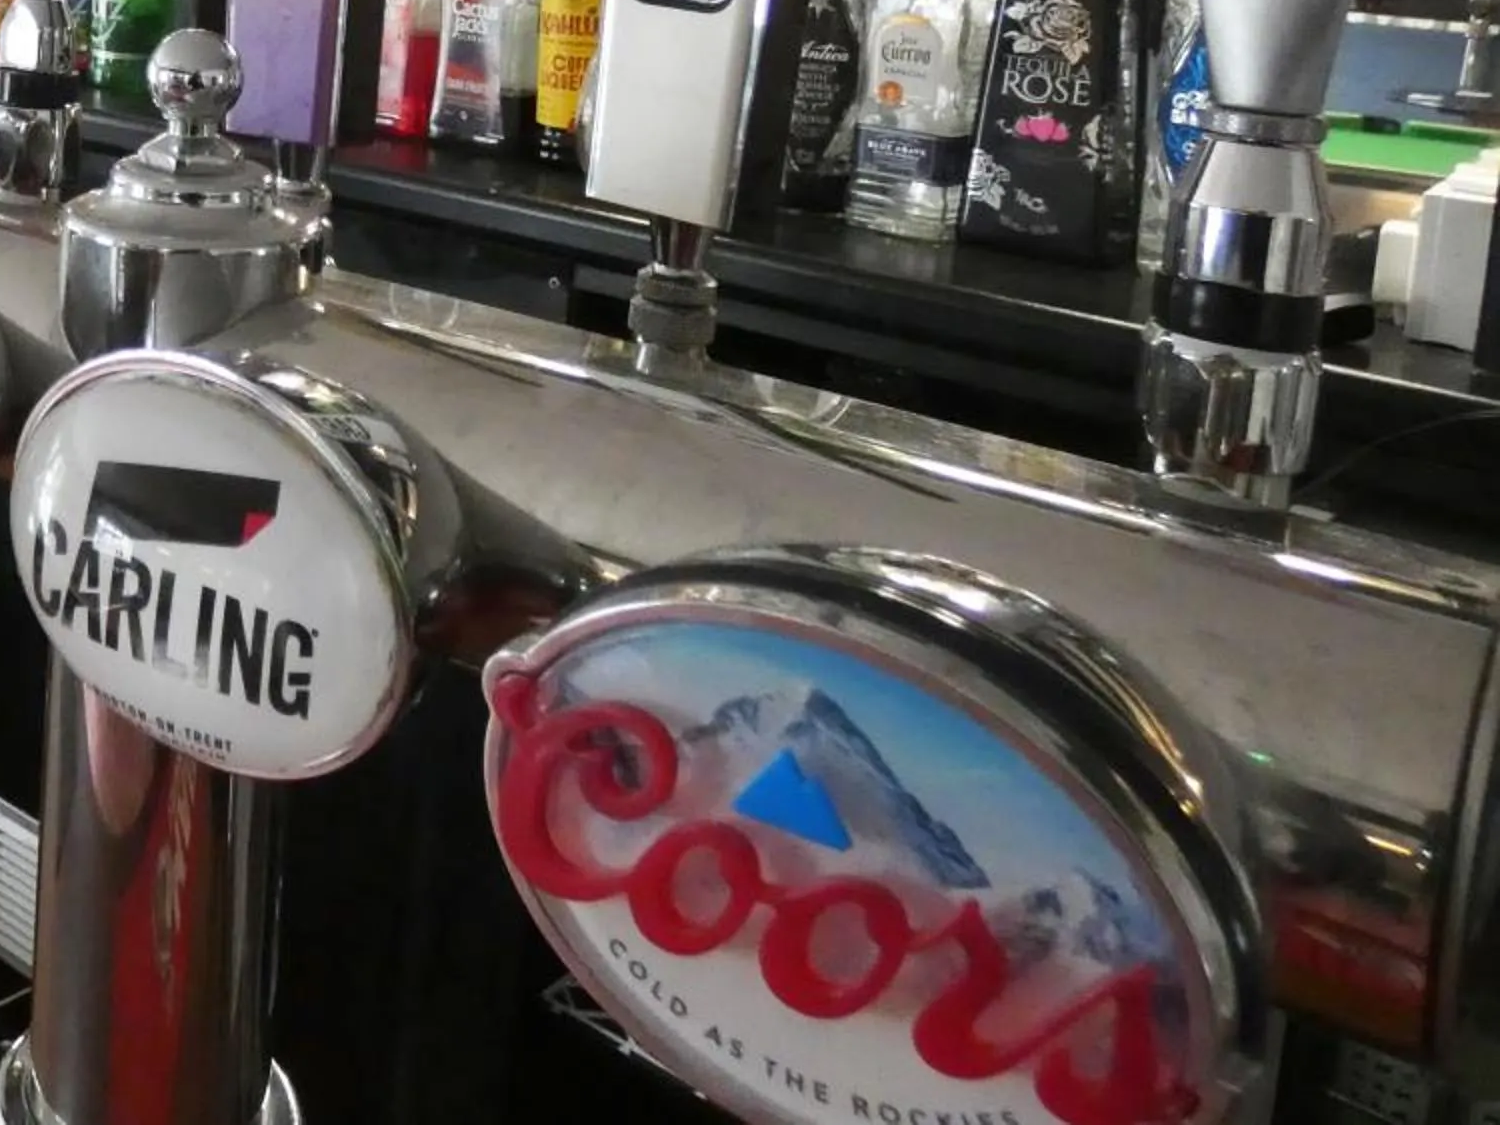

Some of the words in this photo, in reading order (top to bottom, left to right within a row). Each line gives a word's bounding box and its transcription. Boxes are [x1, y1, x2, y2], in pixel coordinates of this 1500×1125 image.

[543, 6, 599, 36] KAHLÚ
[553, 55, 591, 74] COFF
[1004, 53, 1092, 82] TEQUILA
[1001, 68, 1092, 107] ROSE
[32, 520, 314, 721] CARLING
[500, 673, 1200, 1125] Coors
[608, 937, 690, 1018] COLD
[703, 1024, 744, 1060] AS
[762, 1057, 830, 1105] THE
